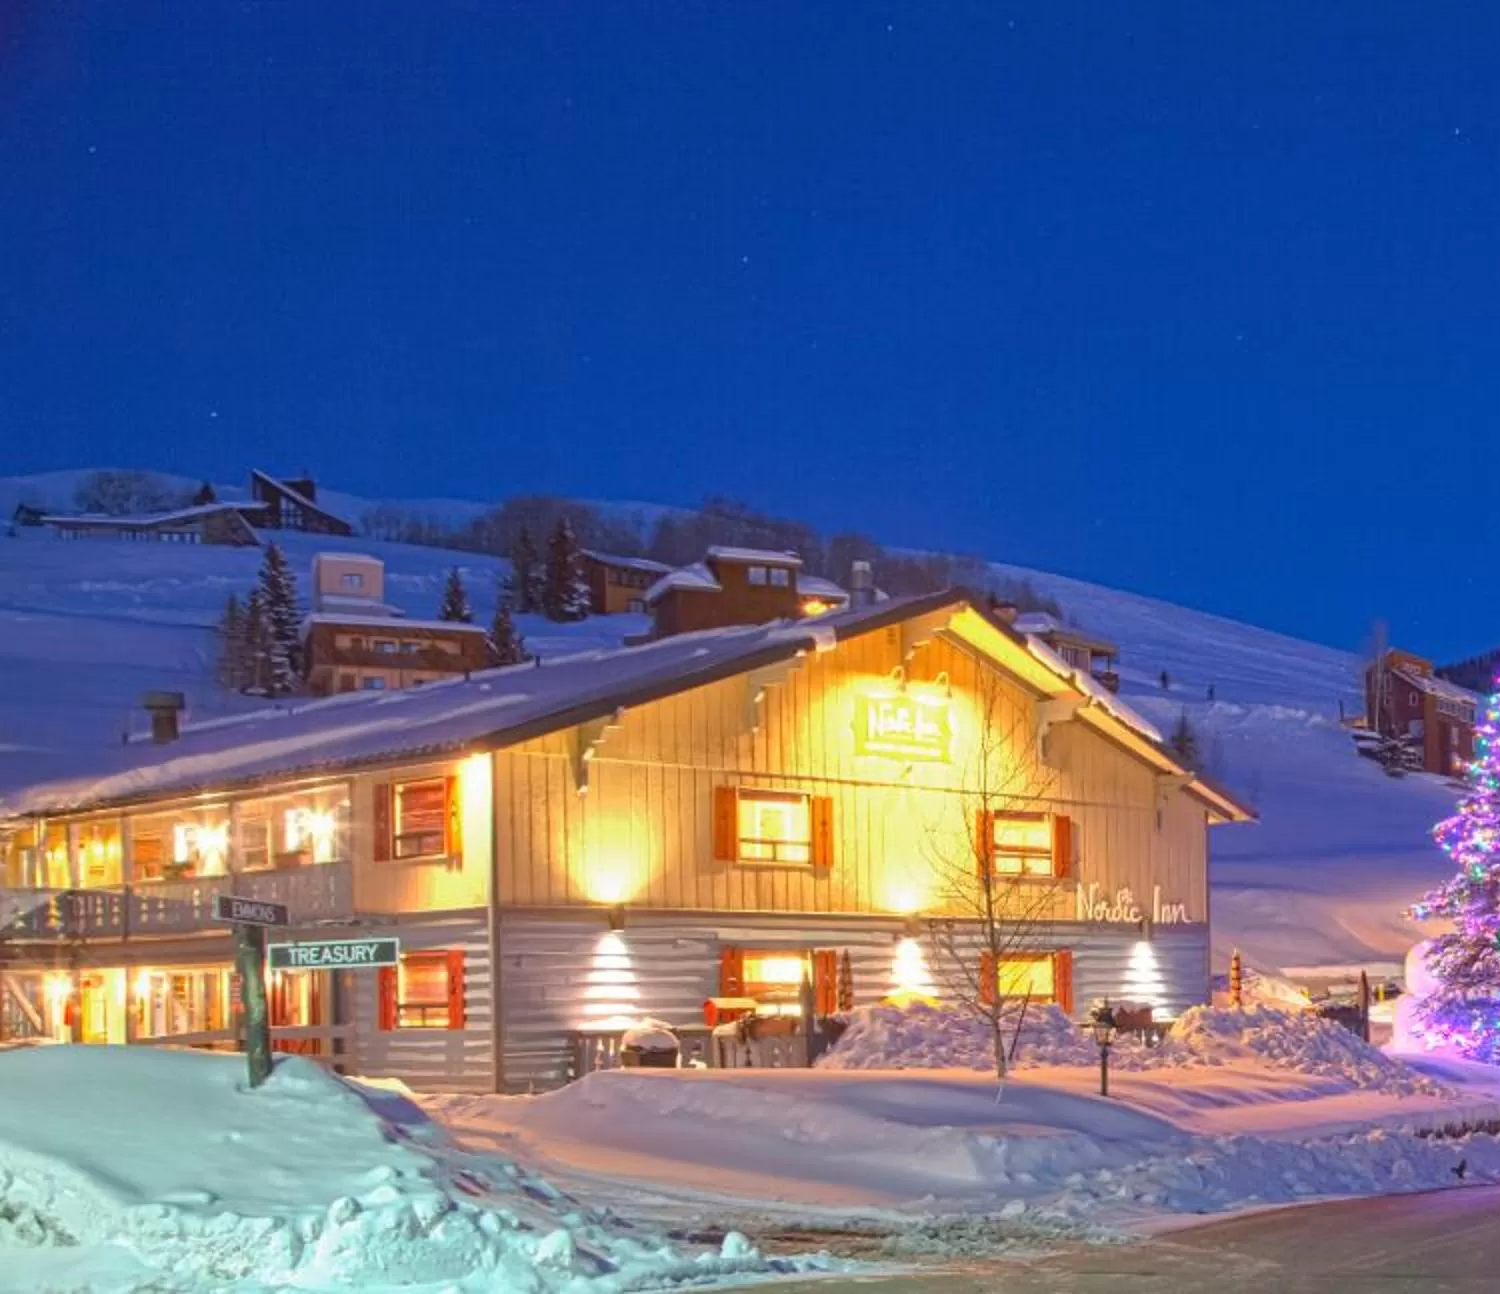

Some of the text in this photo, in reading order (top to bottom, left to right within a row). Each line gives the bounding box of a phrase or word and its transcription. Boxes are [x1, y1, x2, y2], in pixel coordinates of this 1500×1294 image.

[1076, 882, 1192, 924] Nordic Inn
[288, 944, 380, 965] TREASURY
